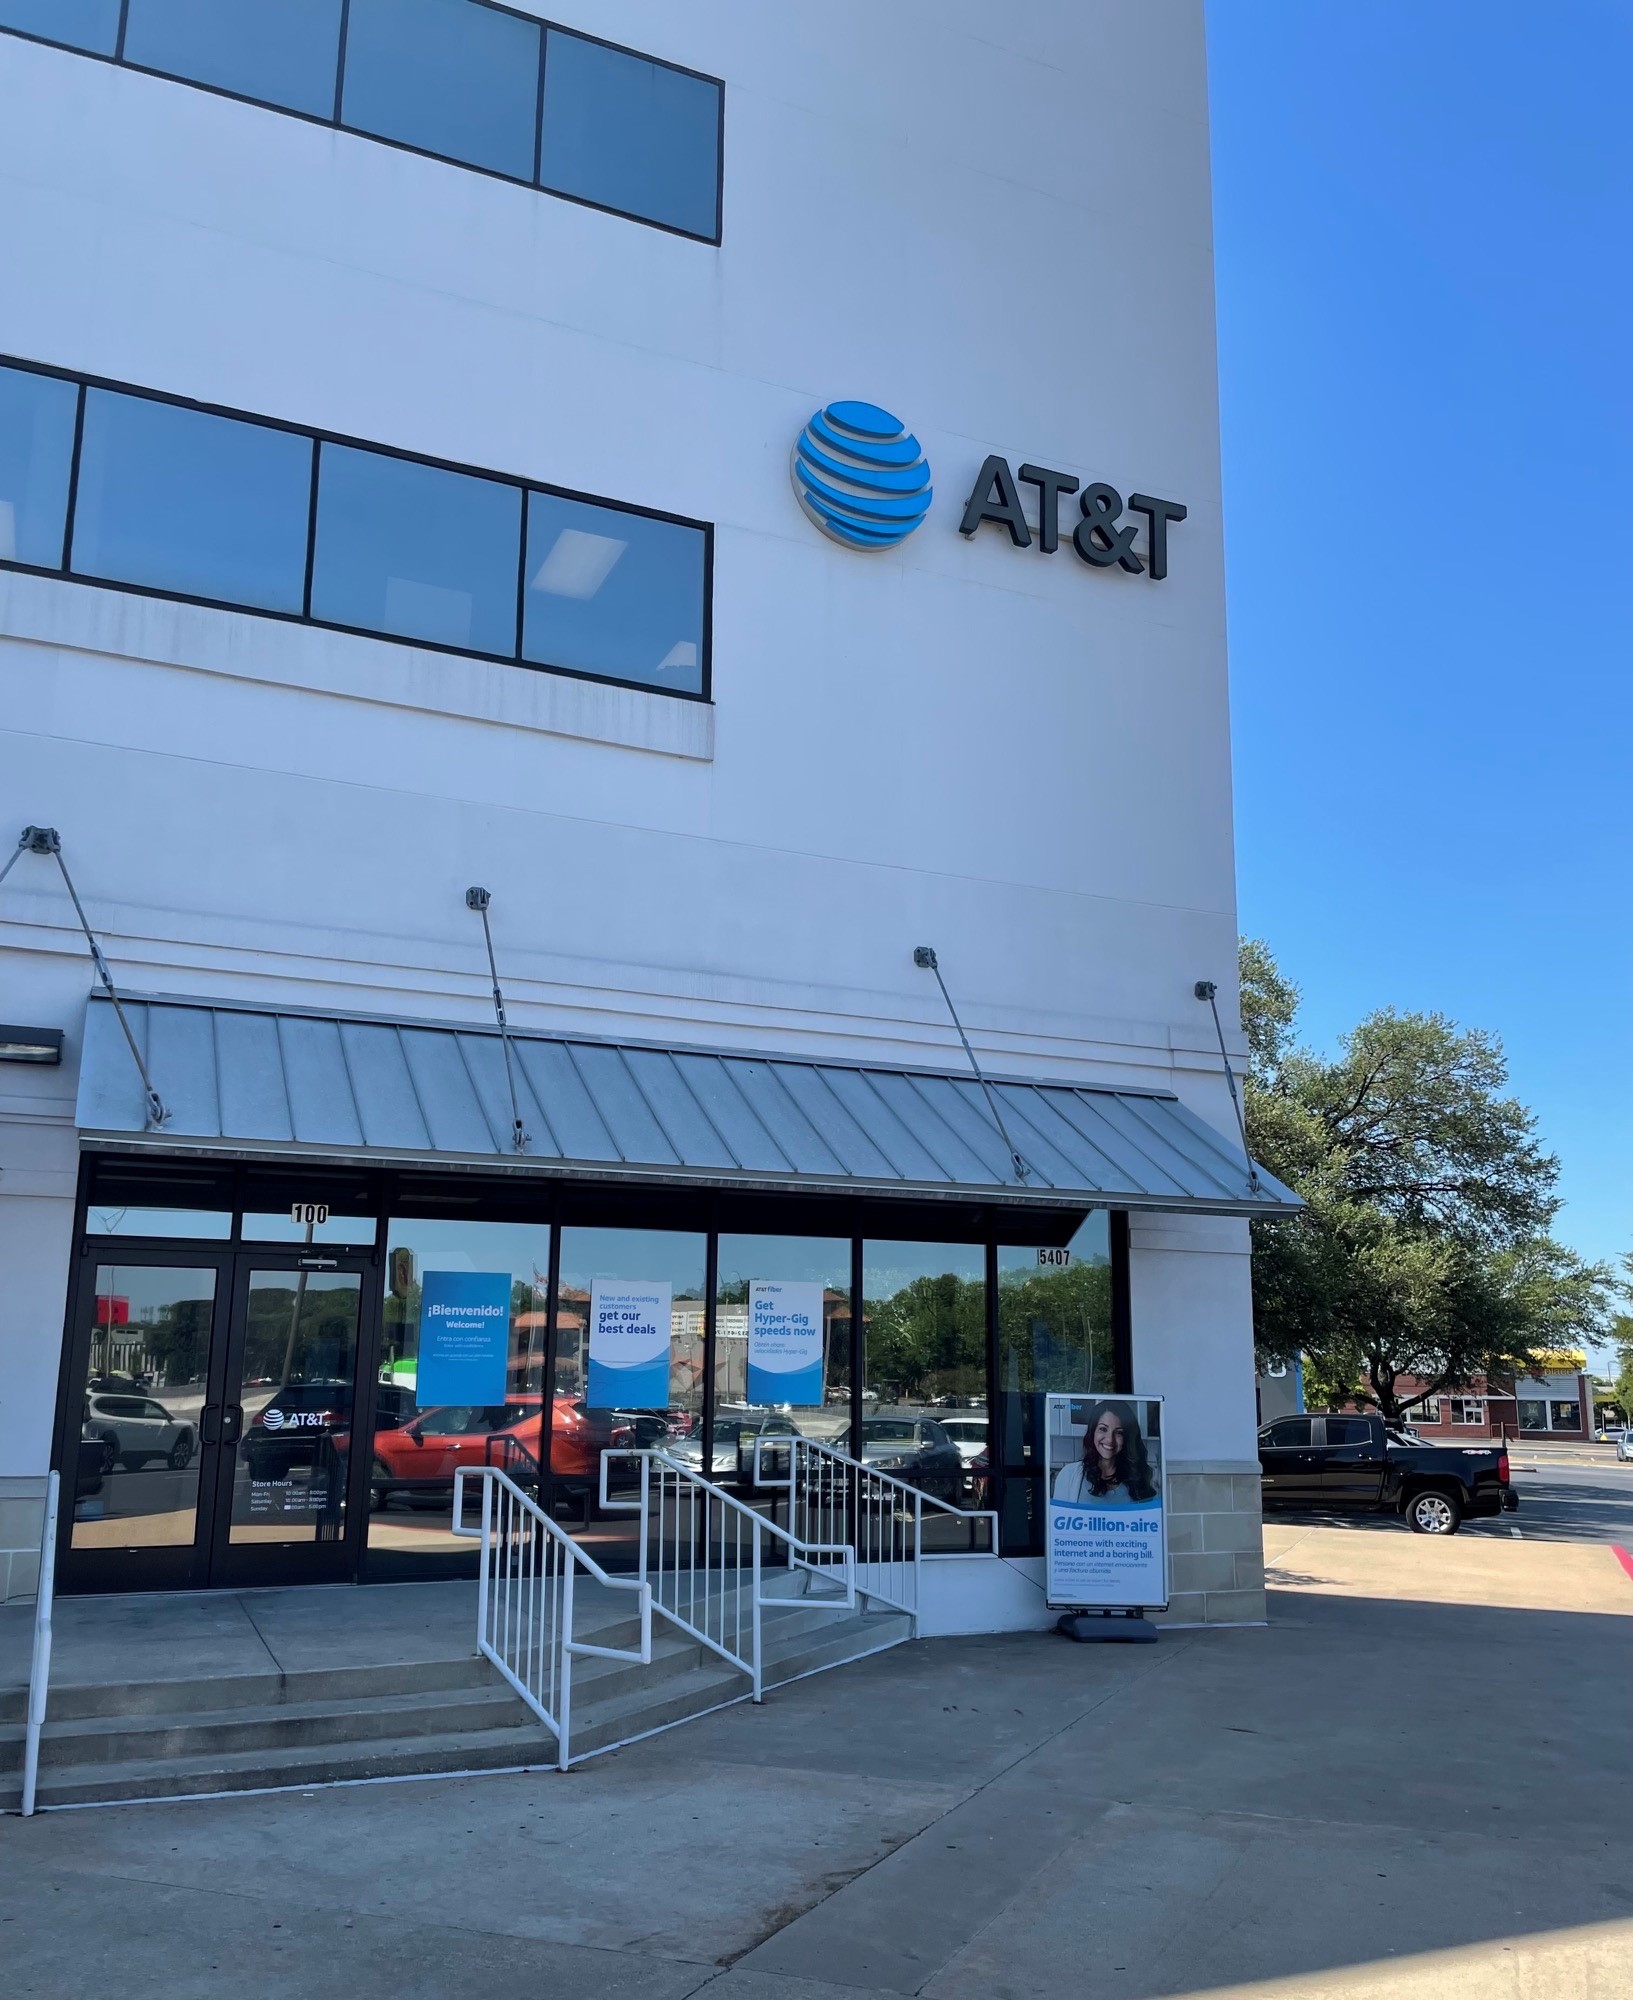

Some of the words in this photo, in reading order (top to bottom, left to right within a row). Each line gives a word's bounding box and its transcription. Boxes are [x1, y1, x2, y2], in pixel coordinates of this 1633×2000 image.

[959, 454, 1187, 580] AT&T
[295, 1204, 327, 1224] 100
[1040, 1249, 1070, 1266] 5407
[632, 1296, 660, 1305] existing
[755, 1300, 774, 1311] Get
[428, 1304, 504, 1317] ¡Bienvenido!
[599, 1311, 619, 1323] get
[621, 1312, 641, 1321] our
[754, 1313, 809, 1326] Hyper-Gig
[446, 1321, 485, 1329] Welcome!
[598, 1323, 624, 1334] best
[626, 1324, 656, 1335] deals
[754, 1326, 792, 1338] speeds
[793, 1328, 816, 1336] now
[288, 1413, 326, 1426] AT&T
[1054, 1539, 1094, 1547] Someone
[1095, 1540, 1114, 1548] with
[1115, 1541, 1148, 1551] exciting
[1054, 1549, 1088, 1558] internet
[1089, 1550, 1105, 1558] and
[1112, 1551, 1139, 1560] boring
[1140, 1551, 1154, 1559] bill.
